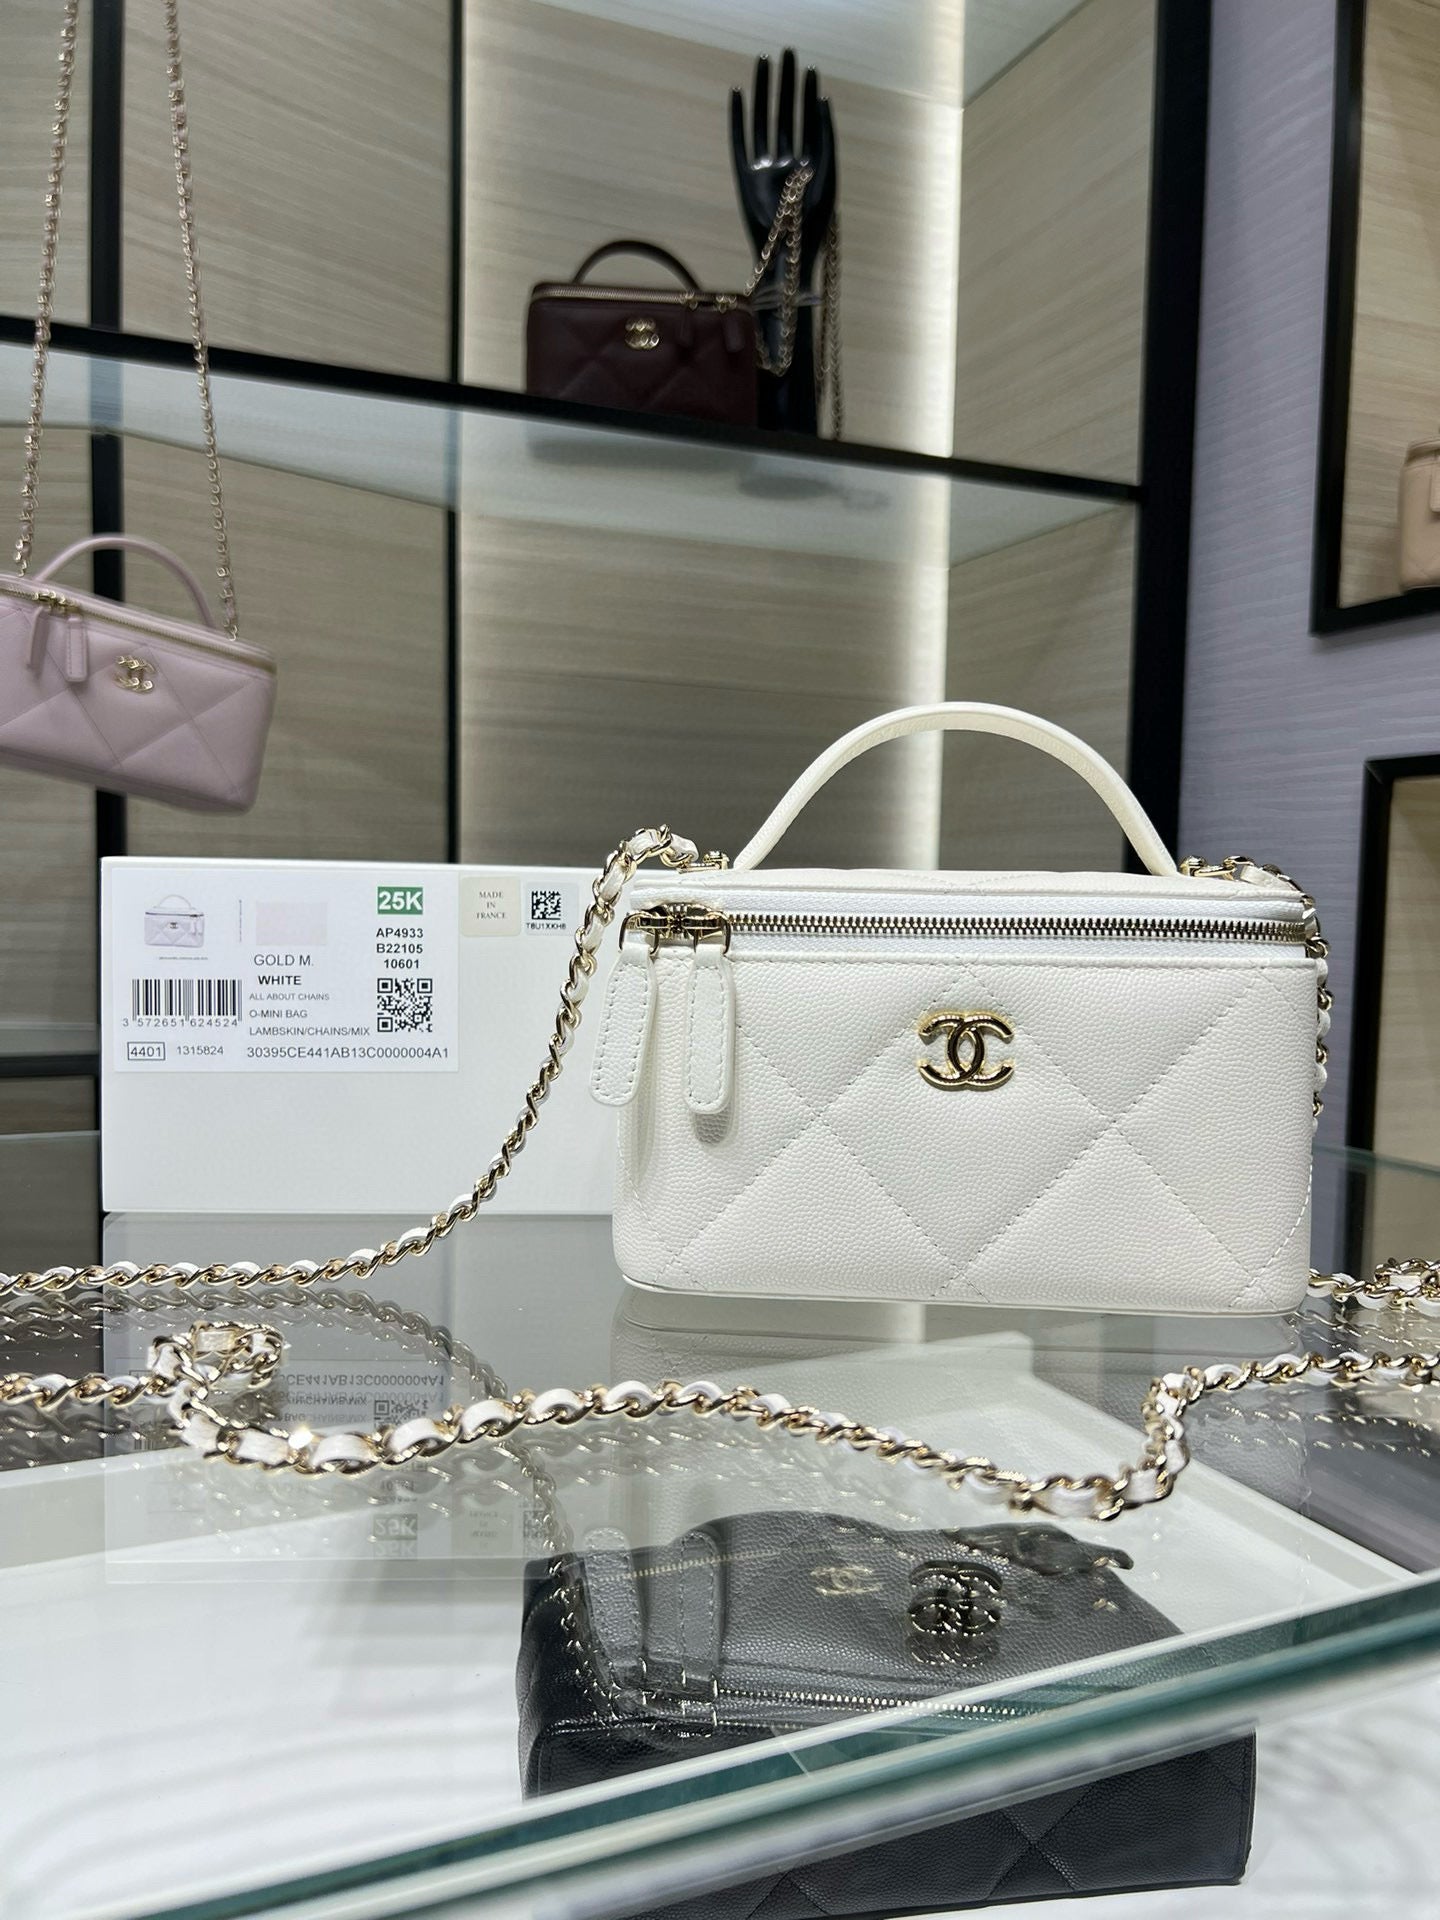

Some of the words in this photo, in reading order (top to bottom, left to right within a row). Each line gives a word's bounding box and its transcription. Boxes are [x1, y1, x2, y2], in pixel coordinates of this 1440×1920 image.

[479, 891, 503, 899] MADE
[378, 891, 423, 911] 25K
[476, 912, 507, 920] FRANCE
[376, 927, 424, 939] AP4933
[376, 943, 424, 954] B22105
[253, 954, 295, 967] GOLD
[299, 954, 314, 967] M.
[384, 958, 420, 970] 10601
[258, 975, 302, 986] WHITE
[249, 993, 264, 1001] ALL
[266, 993, 295, 1001] ABOUT
[298, 993, 330, 1001] CHAINS
[249, 1009, 283, 1018] O-MINI
[285, 1009, 308, 1018] BAG
[249, 1027, 371, 1036] LAMBSKIN/CHAINS/MIX
[130, 1047, 162, 1057] 4401
[176, 1046, 224, 1056] 1315824
[247, 1046, 449, 1059] 30395CE441AB13C0000004A1
